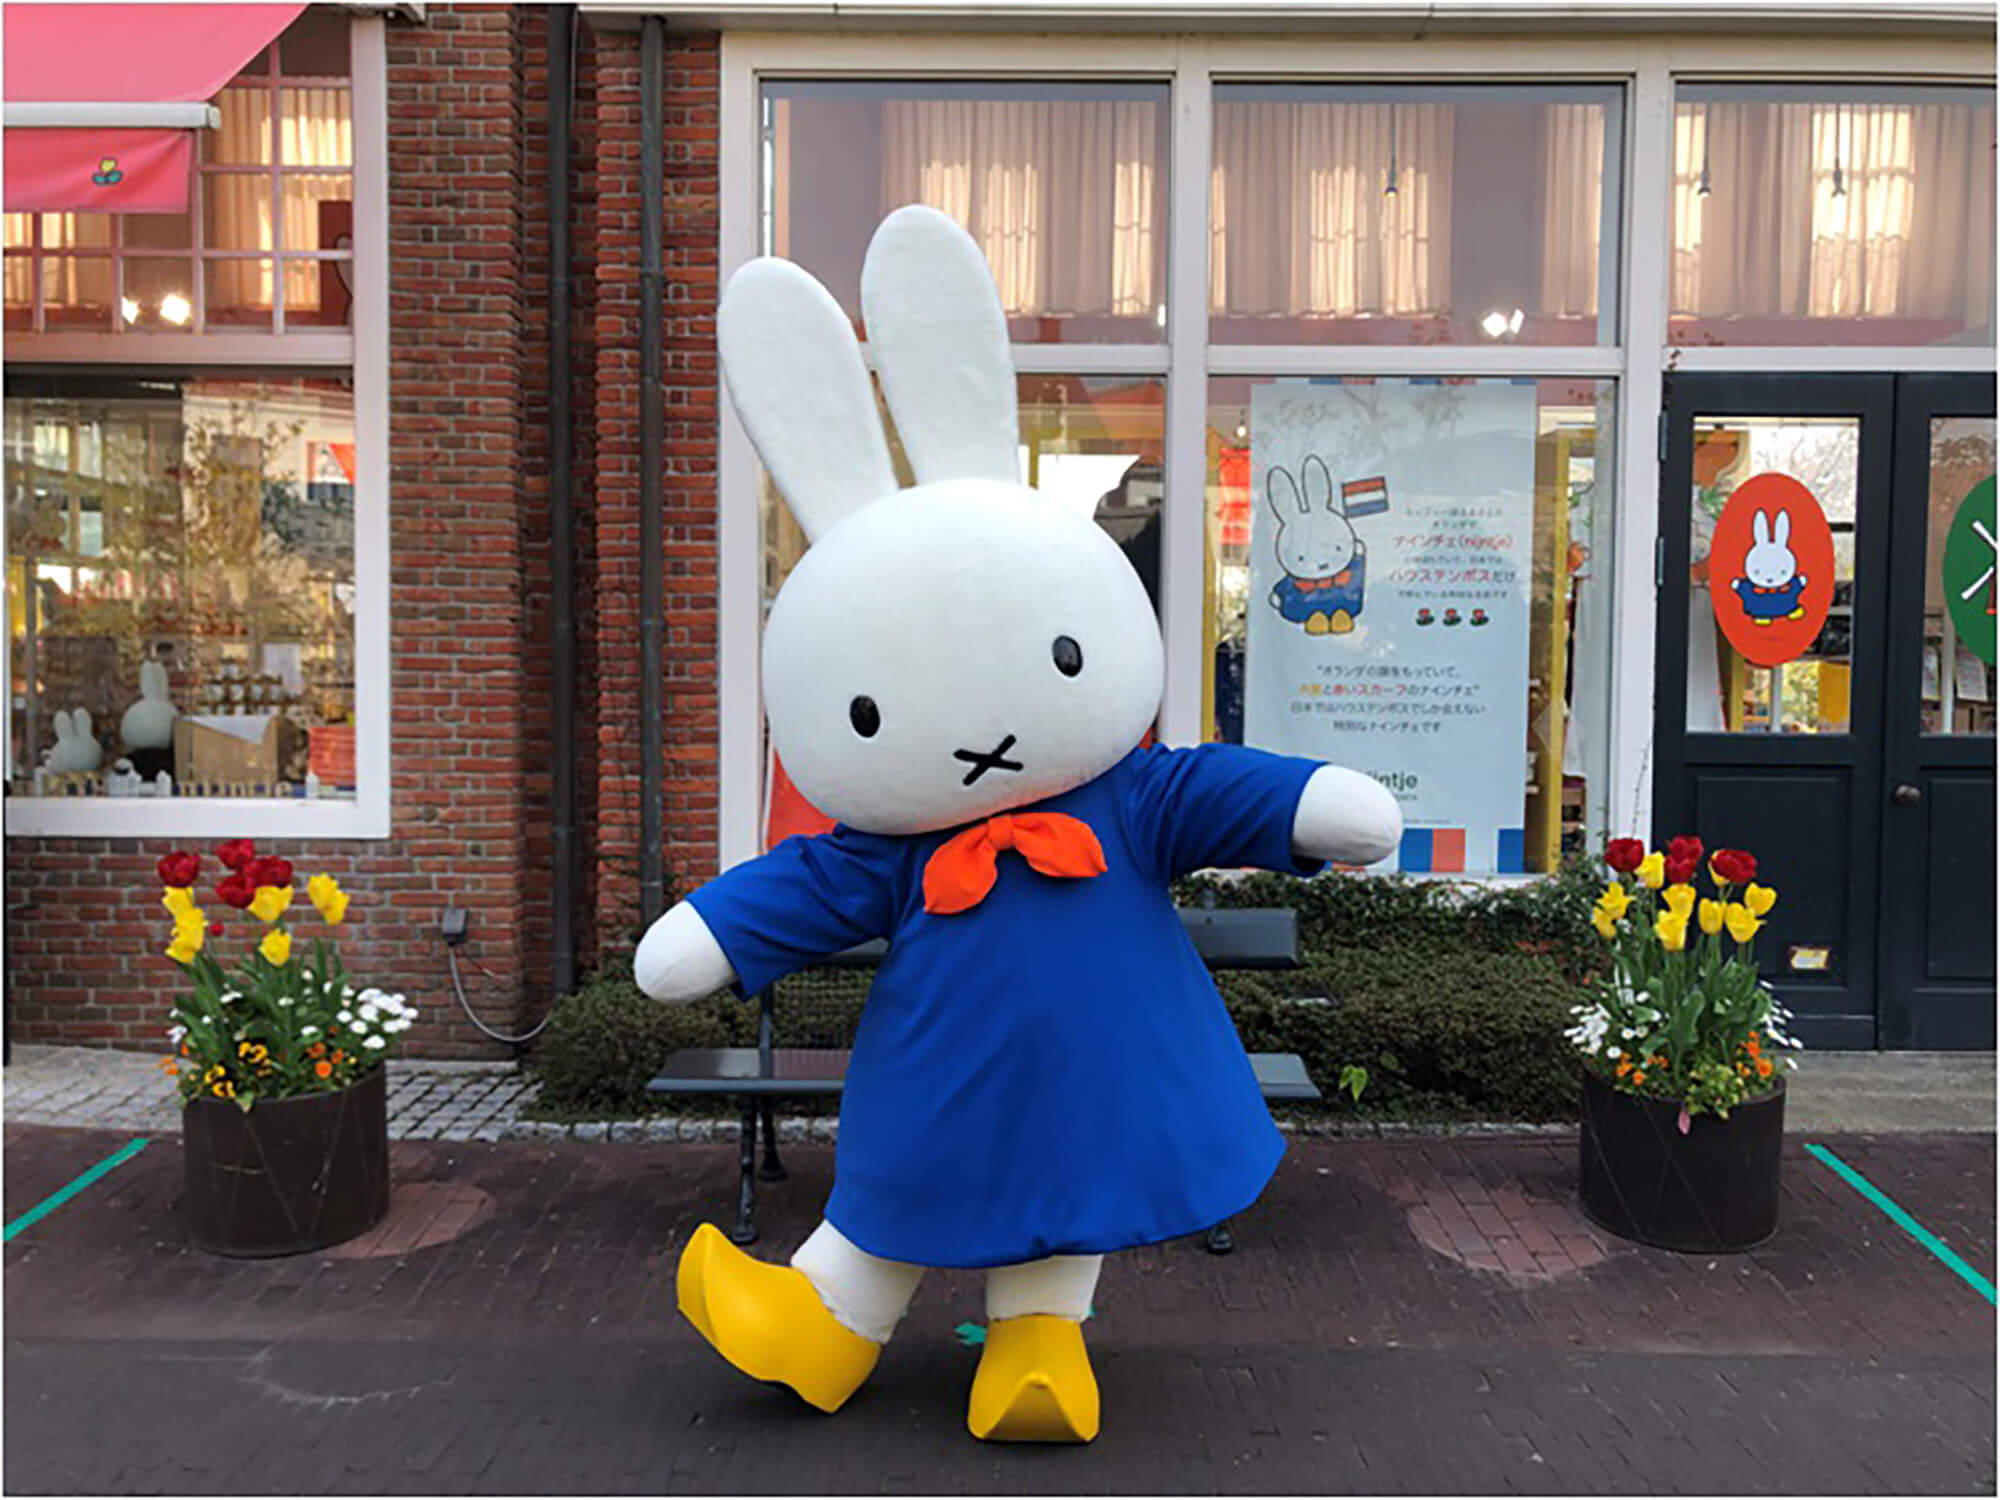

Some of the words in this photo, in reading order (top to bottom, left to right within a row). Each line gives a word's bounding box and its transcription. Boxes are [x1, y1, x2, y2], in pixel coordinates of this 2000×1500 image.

[1389, 567, 1516, 584] ハウステンボスだけ
